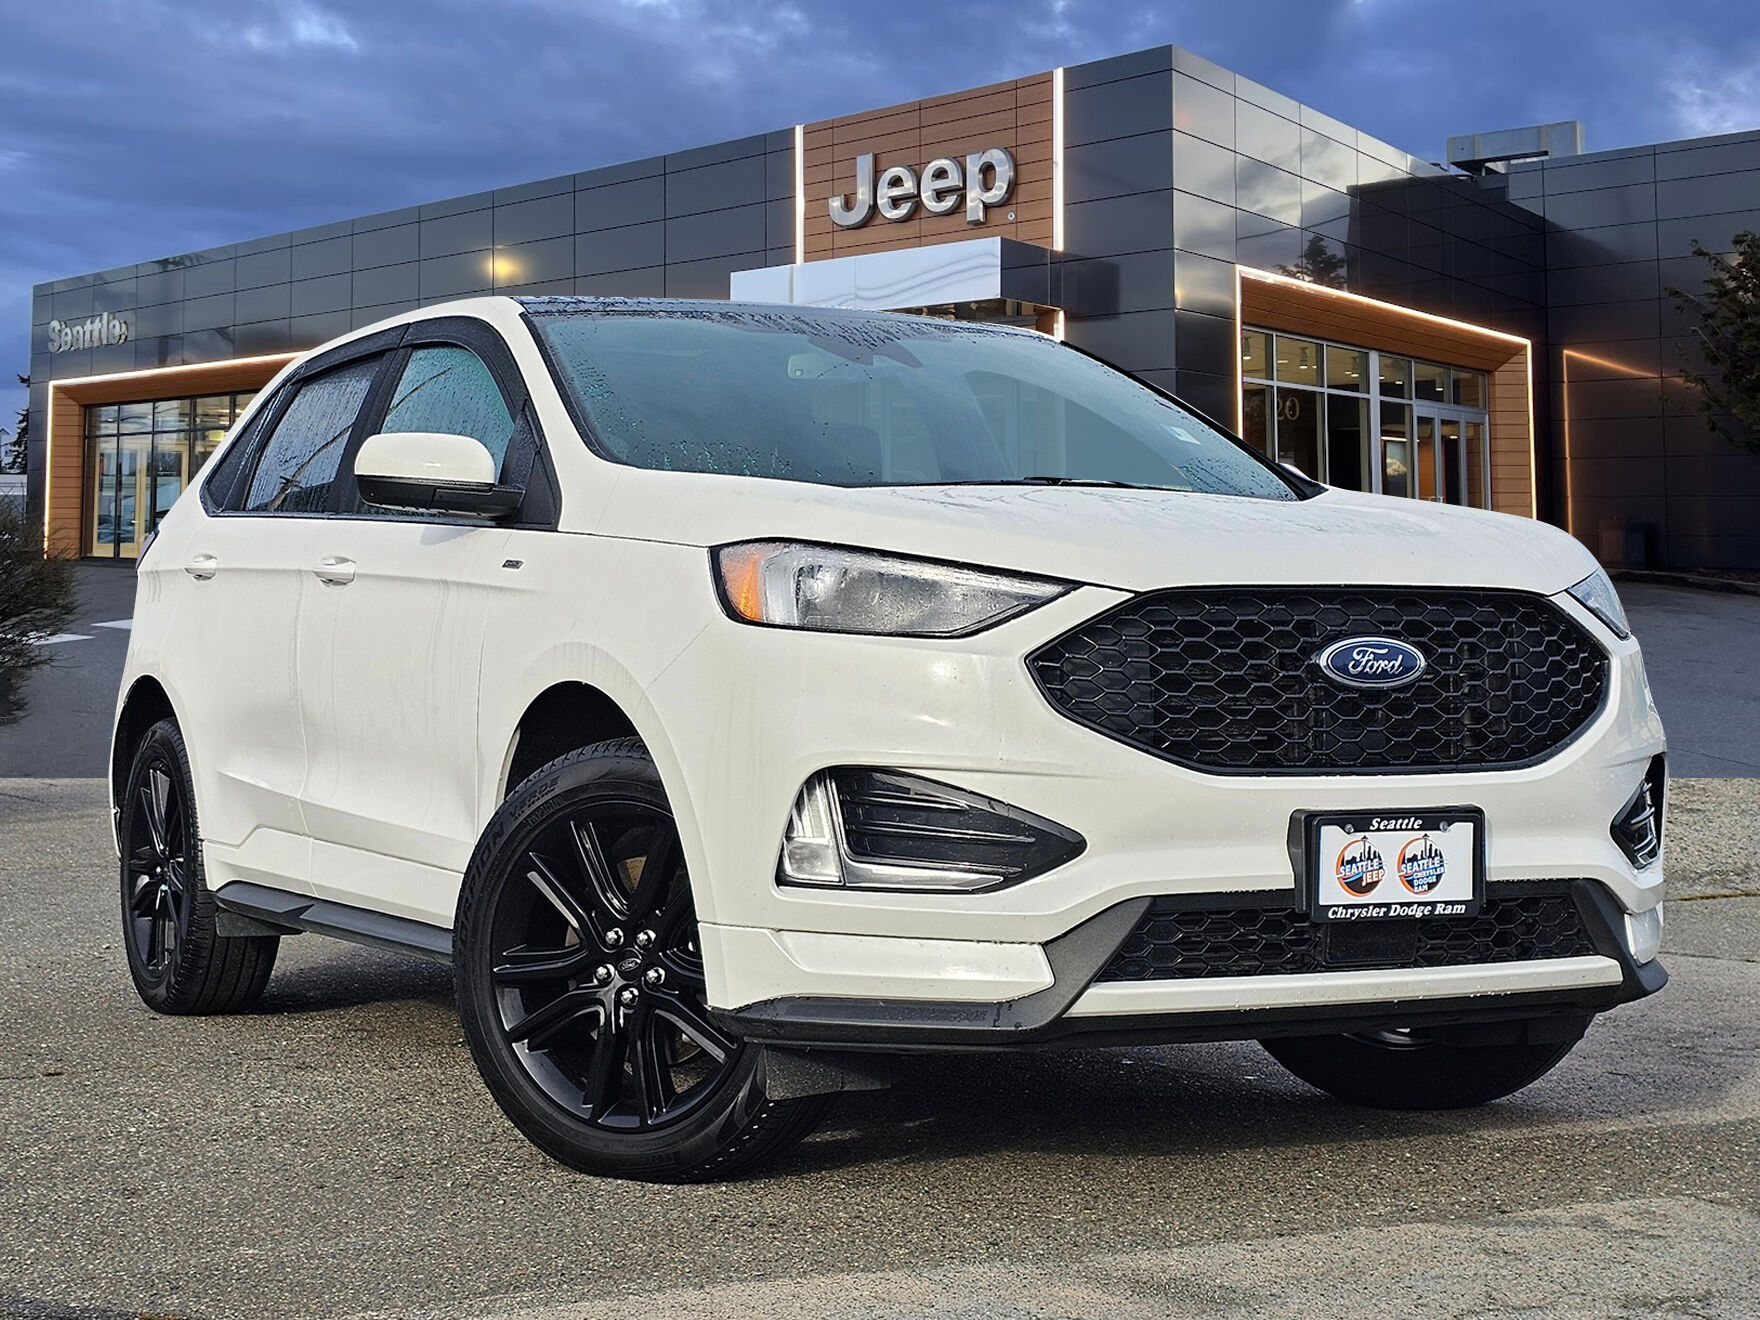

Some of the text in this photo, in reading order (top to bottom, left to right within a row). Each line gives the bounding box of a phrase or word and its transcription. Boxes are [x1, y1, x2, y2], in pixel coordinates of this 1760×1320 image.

[828, 148, 1016, 229] Jeep
[47, 312, 124, 353] Seattle
[1347, 646, 1404, 675] Ford
[1369, 817, 1423, 830] Seattle
[1339, 858, 1379, 876] SEATTLE
[1401, 856, 1440, 875] SEATTLE
[1361, 868, 1385, 887] JEEP
[1413, 875, 1437, 886] DODGE
[1413, 884, 1428, 893] RAM
[1328, 903, 1466, 921] Chrysler Dodge Ram
